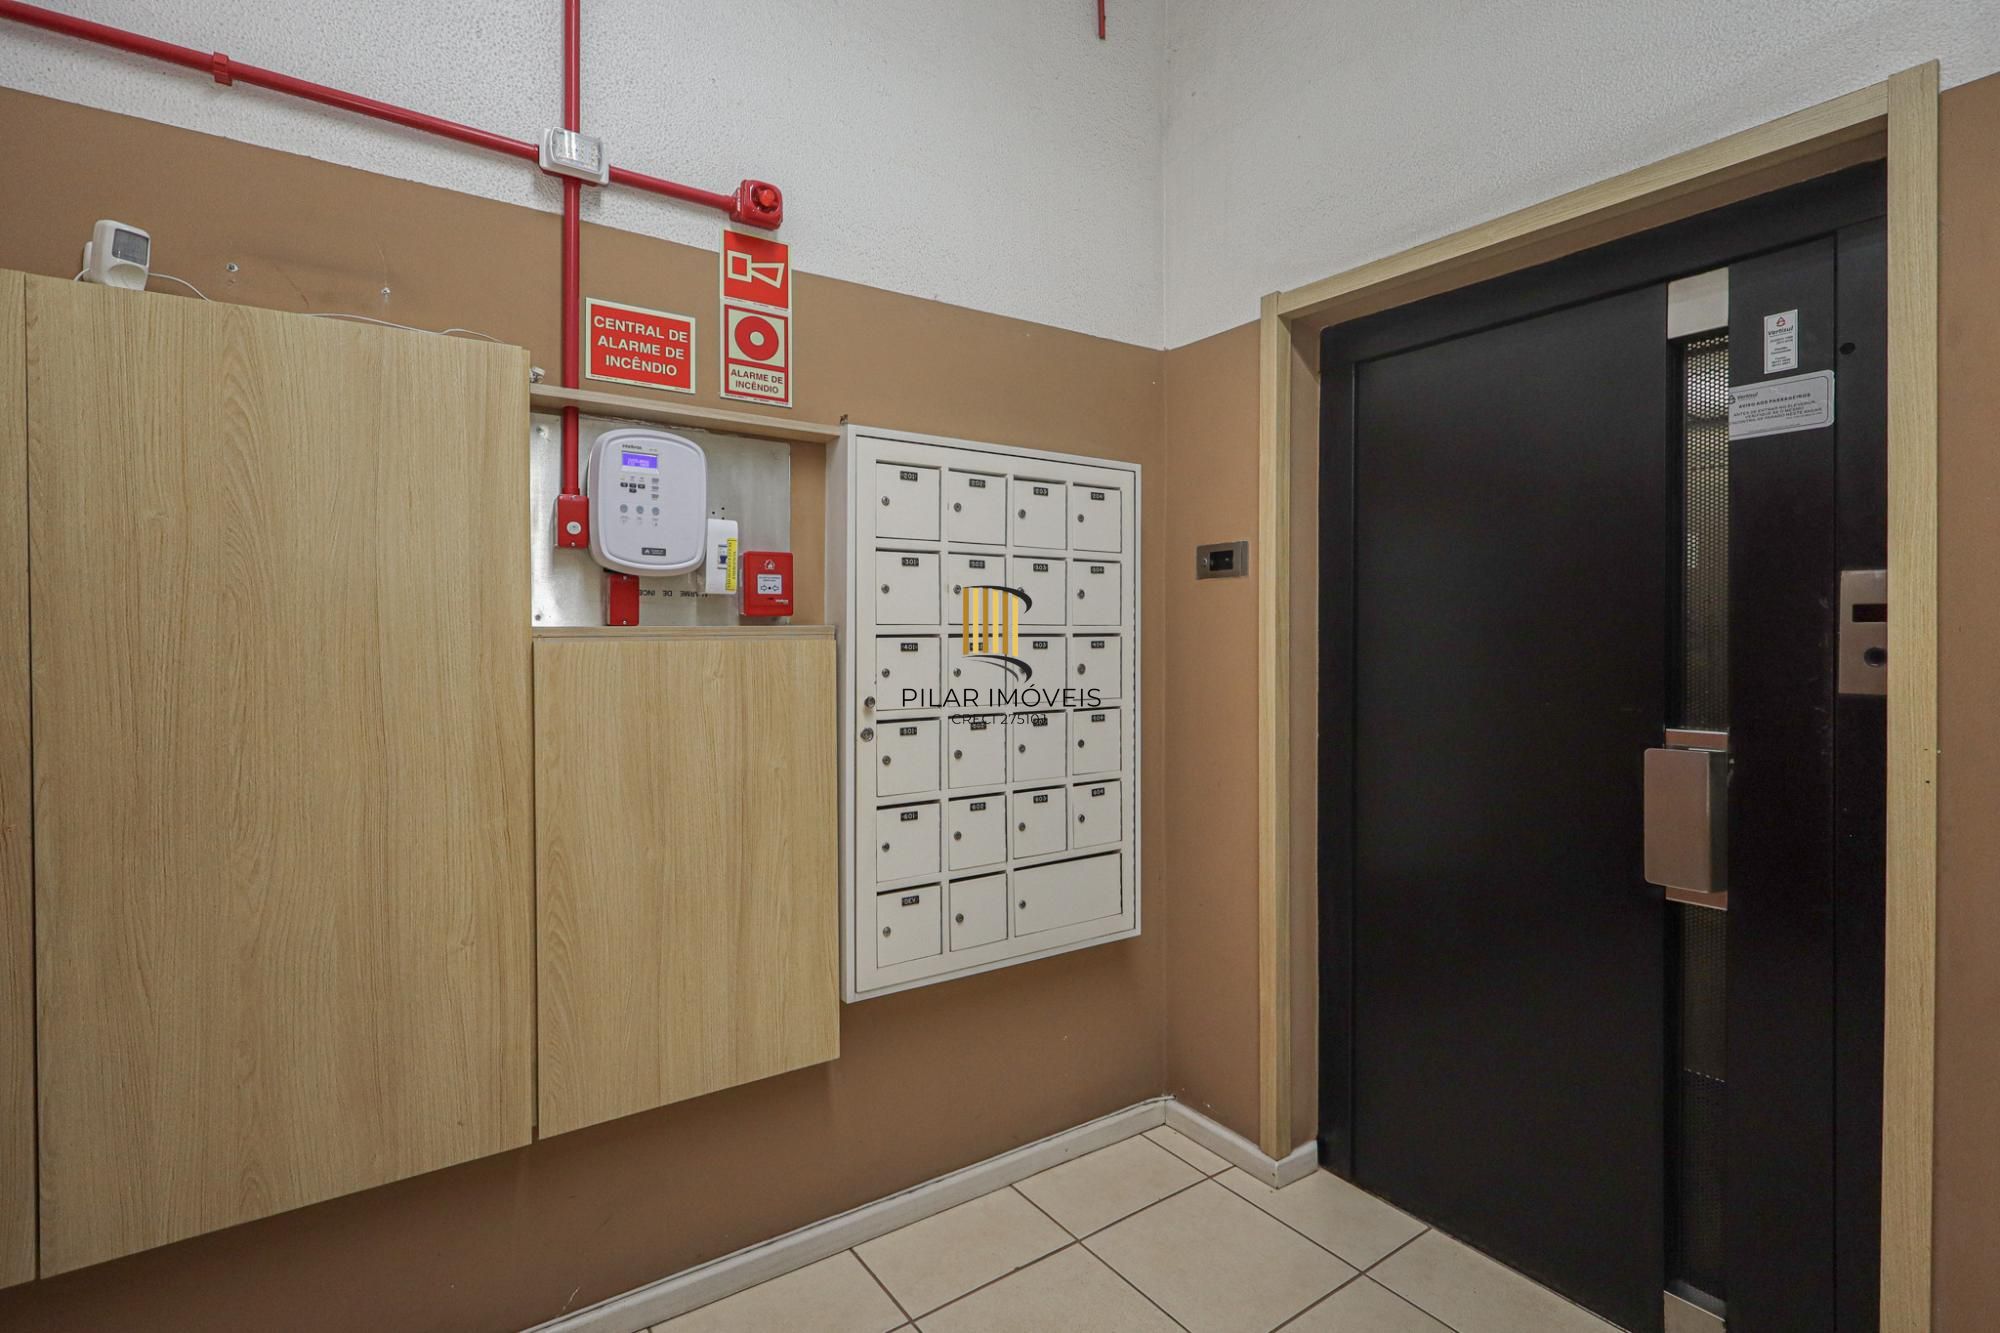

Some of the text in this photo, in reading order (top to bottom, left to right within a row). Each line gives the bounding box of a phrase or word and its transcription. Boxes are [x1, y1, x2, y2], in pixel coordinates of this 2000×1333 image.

[593, 315, 689, 343] CENTRAL DE
[597, 335, 685, 360] ALARME DE
[605, 354, 678, 376] INCÊNDIO
[730, 368, 784, 385] ALARME DE
[735, 379, 779, 394] INCÊNDIO
